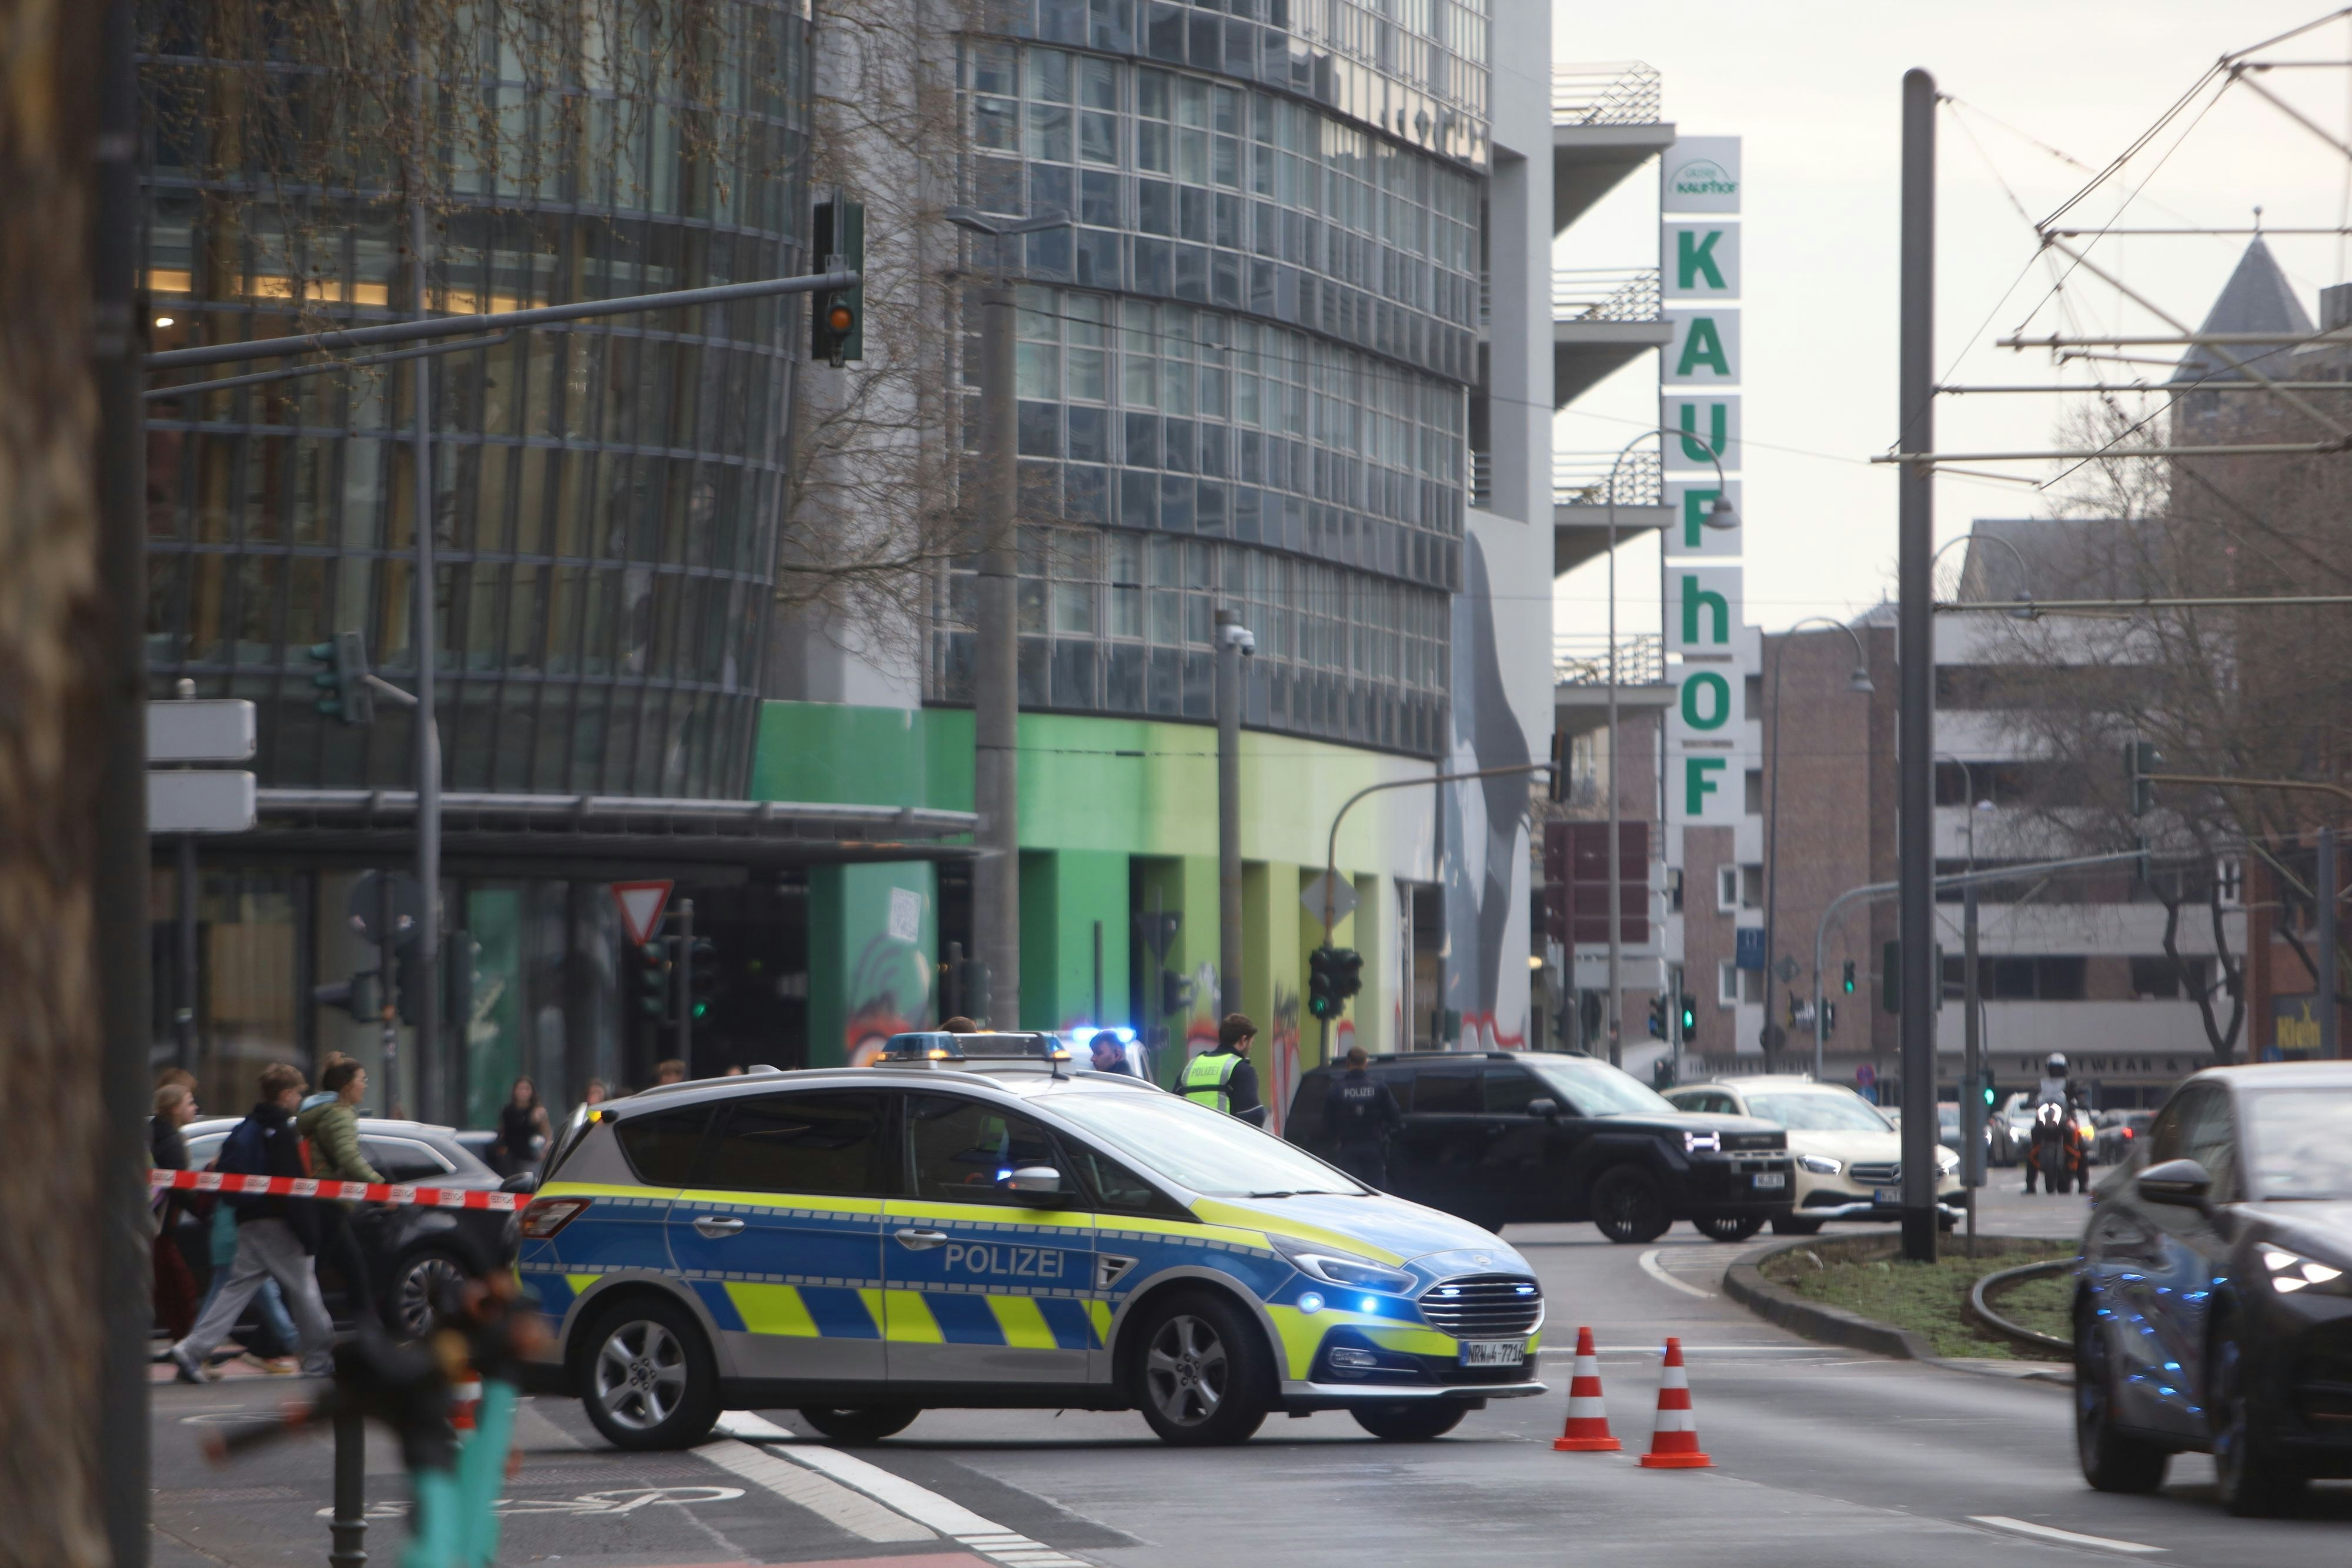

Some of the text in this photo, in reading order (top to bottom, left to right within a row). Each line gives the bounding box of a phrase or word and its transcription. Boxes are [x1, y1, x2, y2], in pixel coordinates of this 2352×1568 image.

[1192, 1066, 1220, 1076] POLIZEI
[1344, 1086, 1375, 1098] POLIZEI
[945, 1243, 1064, 1278] POLIZEI
[1468, 1344, 1487, 1363] NRW
